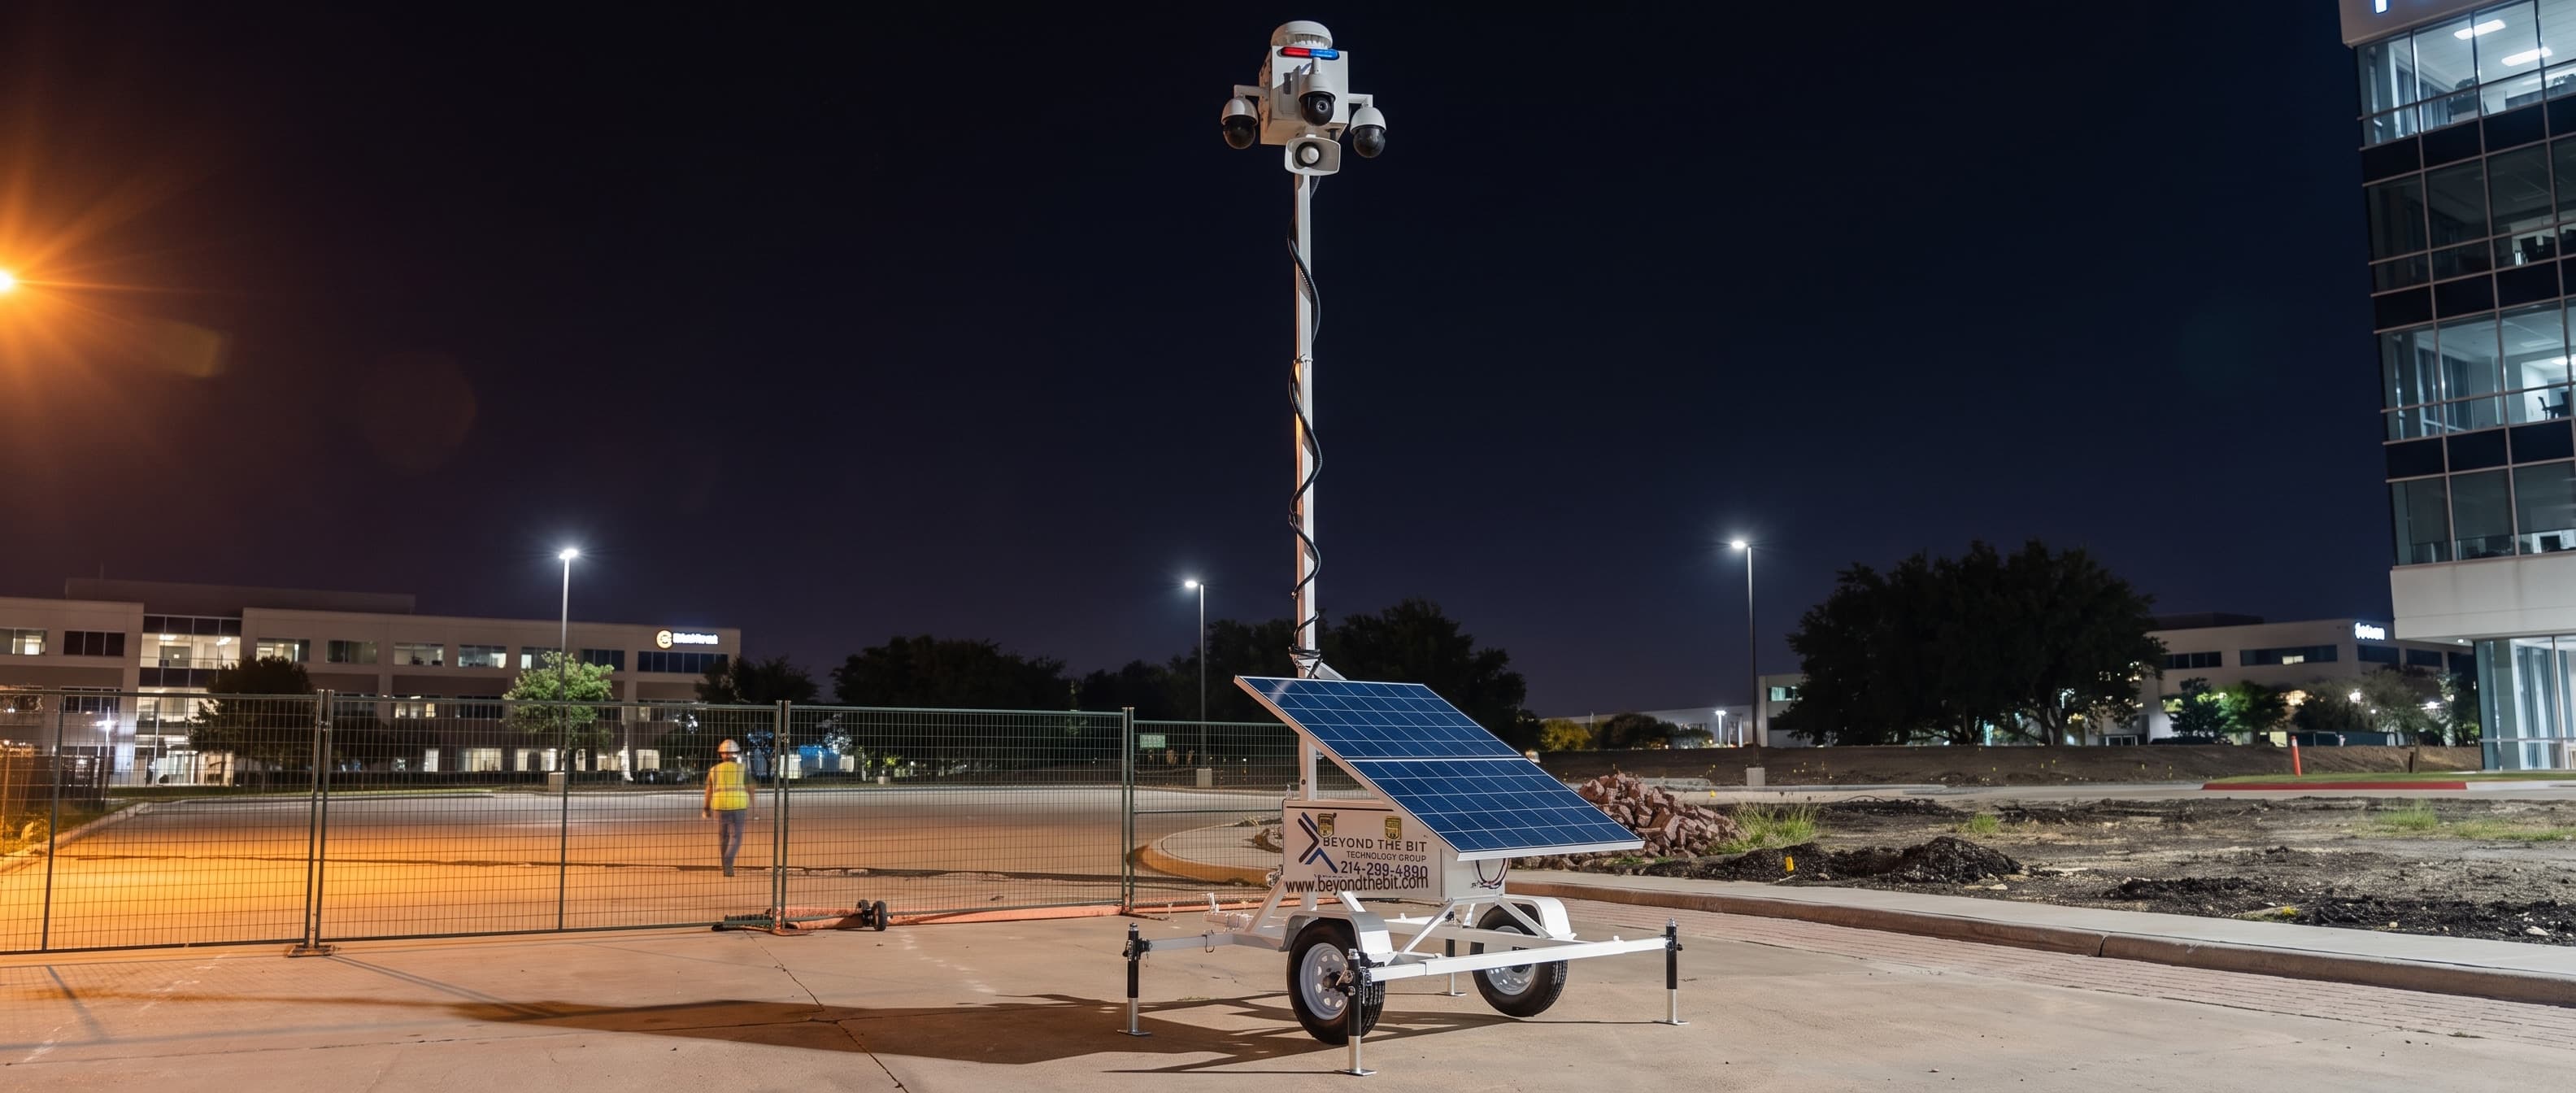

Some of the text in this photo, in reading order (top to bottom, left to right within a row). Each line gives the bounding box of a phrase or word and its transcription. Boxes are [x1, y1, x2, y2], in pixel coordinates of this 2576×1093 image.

[1323, 837, 1427, 852] BEYOND THE BIT
[1347, 851, 1426, 863] TECHNOLOGY GROUP
[1340, 860, 1428, 877] 214-299-4890
[1286, 873, 1429, 895] www.beyondthebit.com
